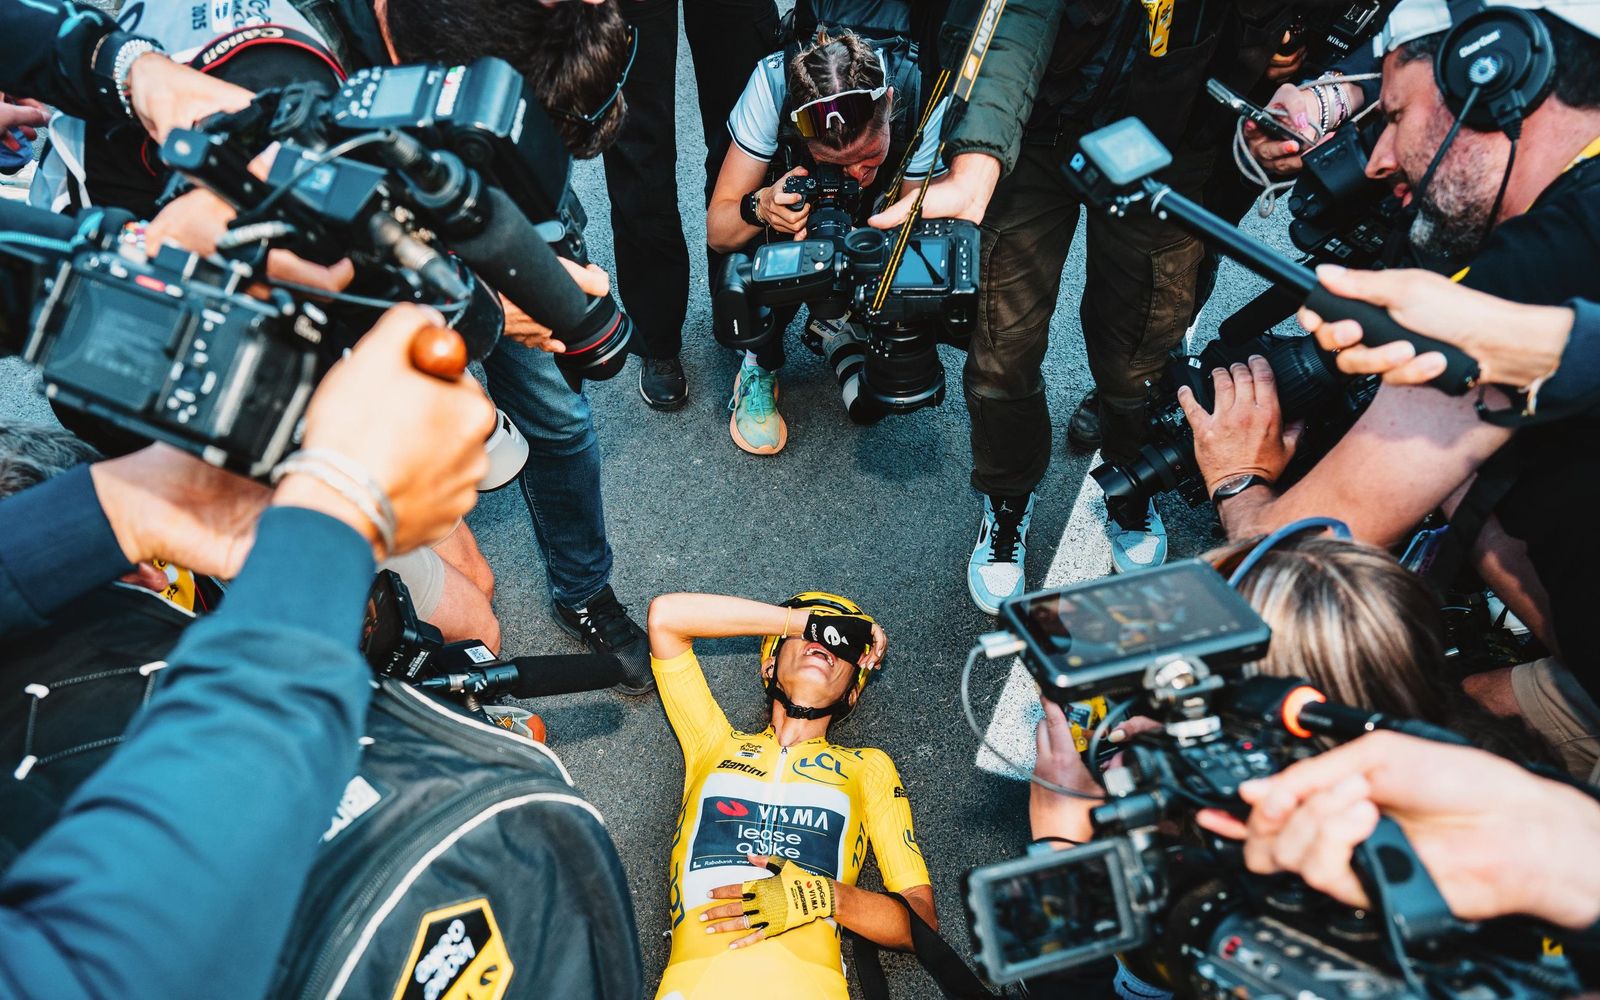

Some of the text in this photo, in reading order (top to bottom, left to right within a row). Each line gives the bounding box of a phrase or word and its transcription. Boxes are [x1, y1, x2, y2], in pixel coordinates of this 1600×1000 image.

[202, 26, 285, 65] Canon
[1326, 34, 1349, 50] Nikon
[716, 759, 768, 777] Santini
[799, 752, 849, 780] LCL
[758, 804, 829, 831] VISMA
[737, 824, 802, 845] lease
[815, 879, 827, 909] GripGrab
